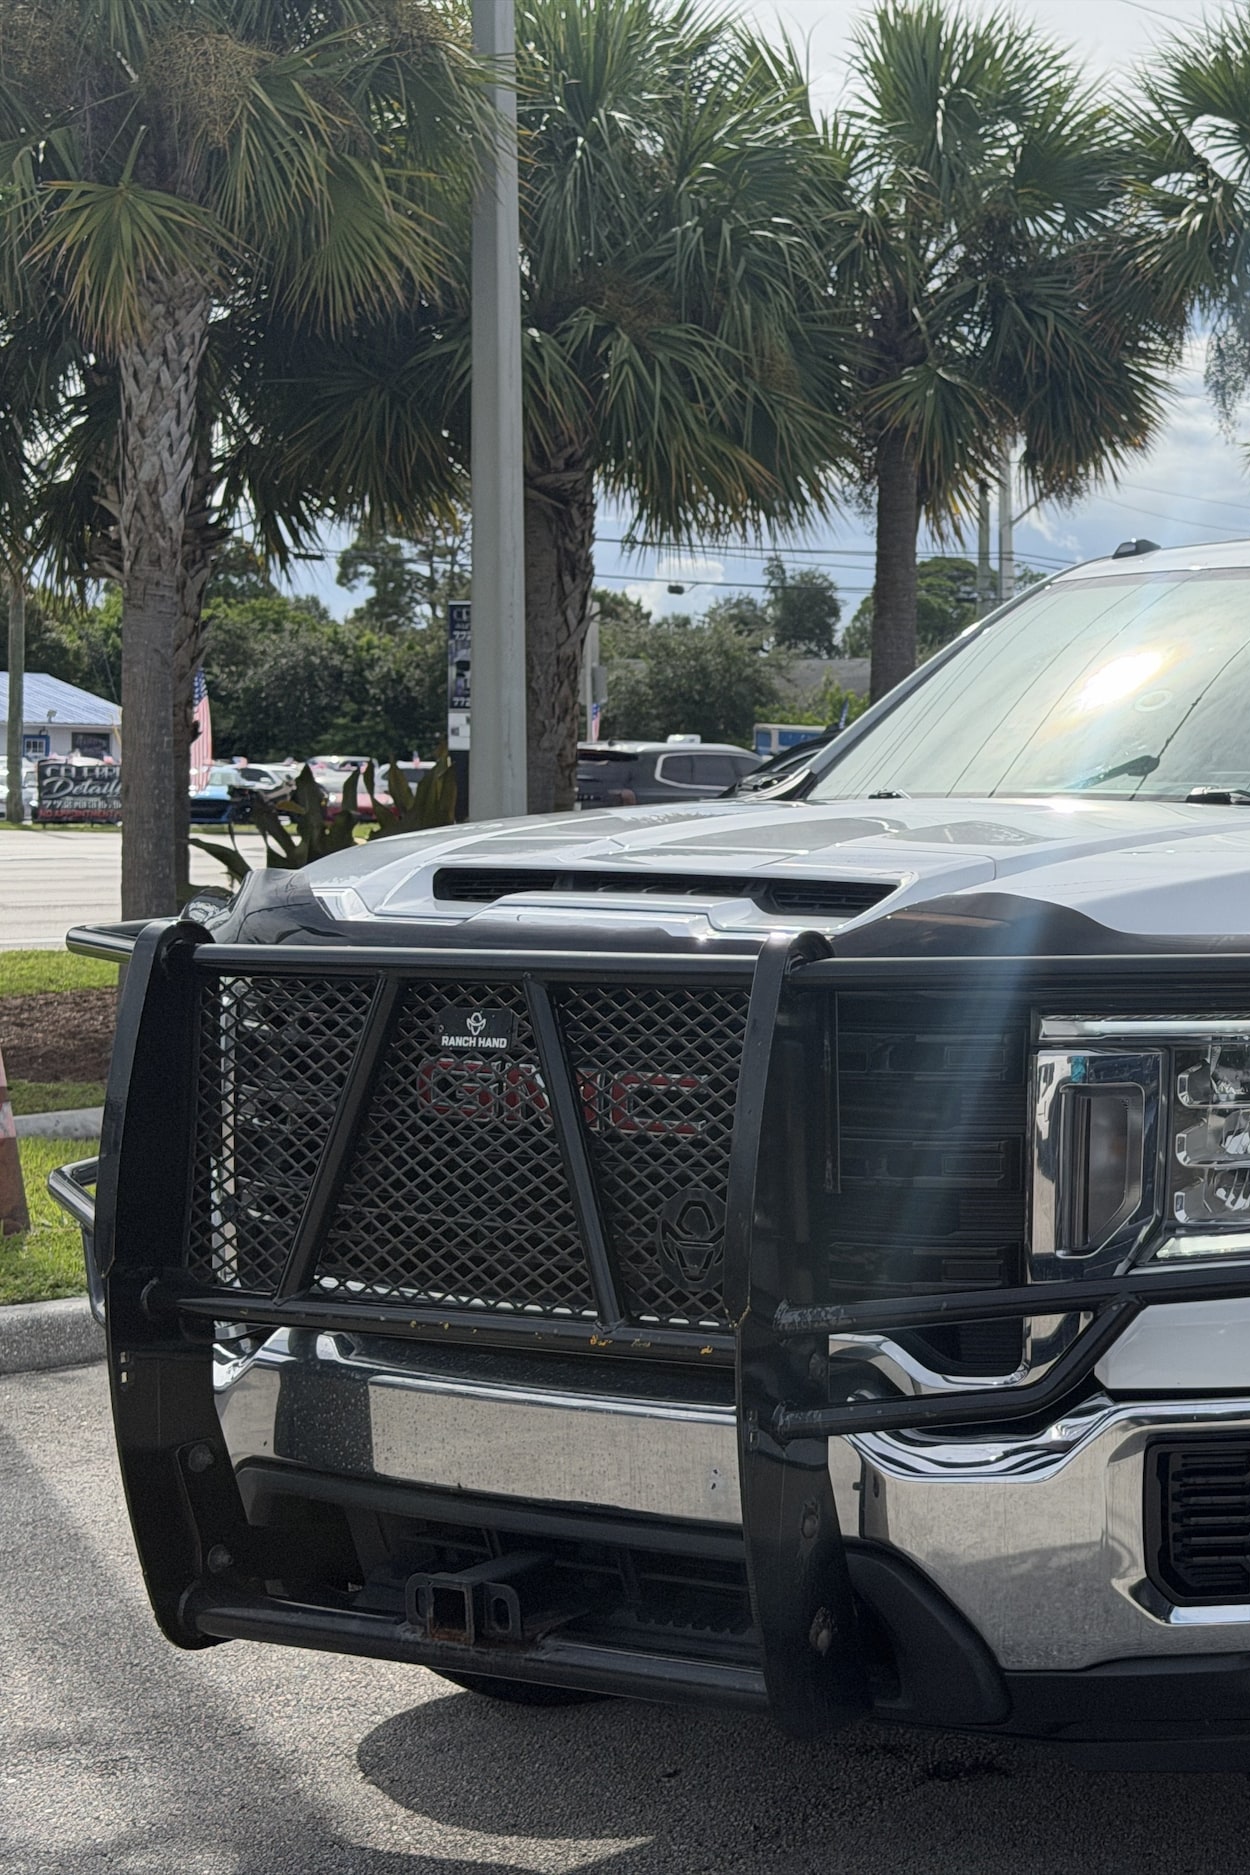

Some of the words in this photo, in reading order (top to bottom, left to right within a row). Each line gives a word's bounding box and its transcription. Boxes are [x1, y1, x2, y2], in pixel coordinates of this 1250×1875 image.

[441, 1035, 477, 1048] RANCH
[478, 1037, 507, 1049] HAND
[416, 1056, 707, 1138] GMC
